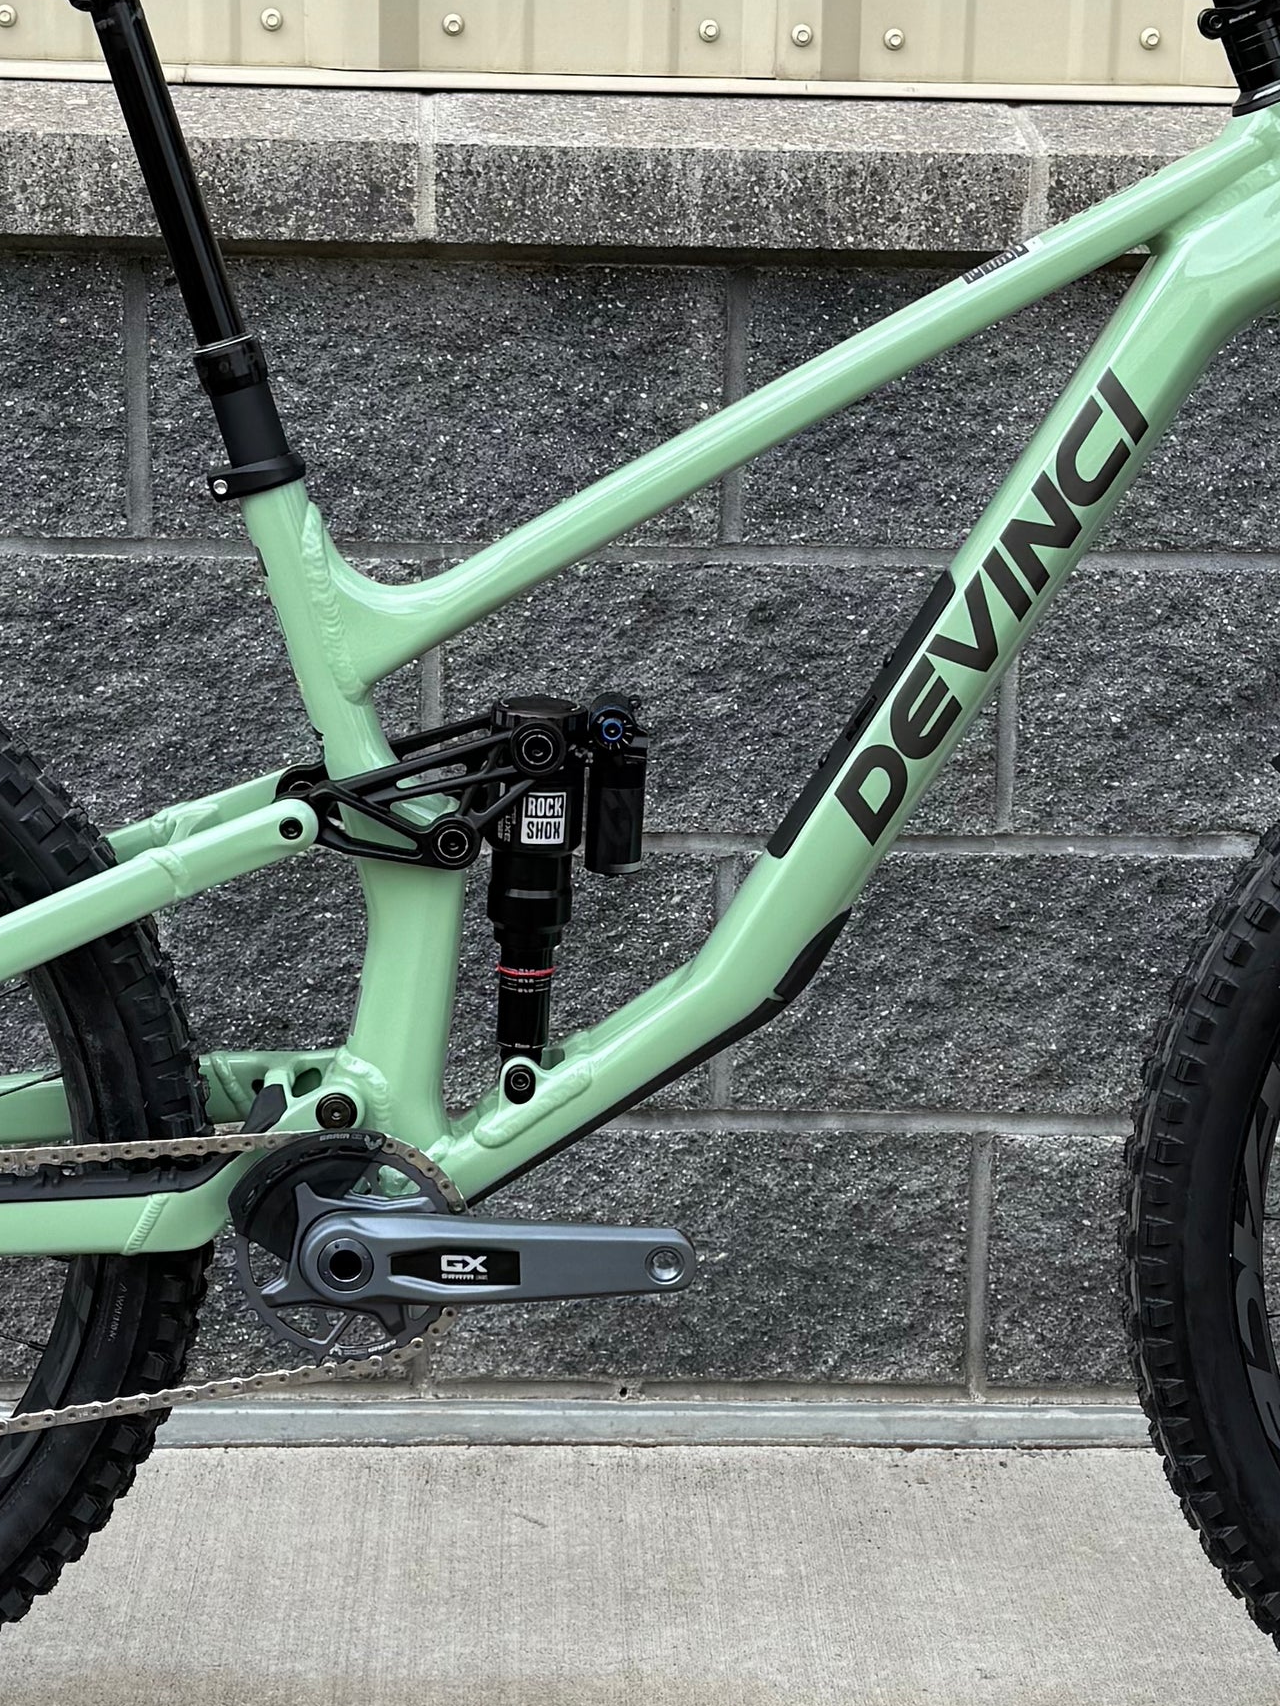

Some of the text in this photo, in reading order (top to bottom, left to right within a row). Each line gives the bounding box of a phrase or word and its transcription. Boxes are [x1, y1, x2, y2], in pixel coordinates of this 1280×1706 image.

[836, 366, 1151, 846] DEVINCI
[527, 797, 562, 816] ROCK
[527, 821, 561, 839] SHOX
[440, 1254, 489, 1273] GX
